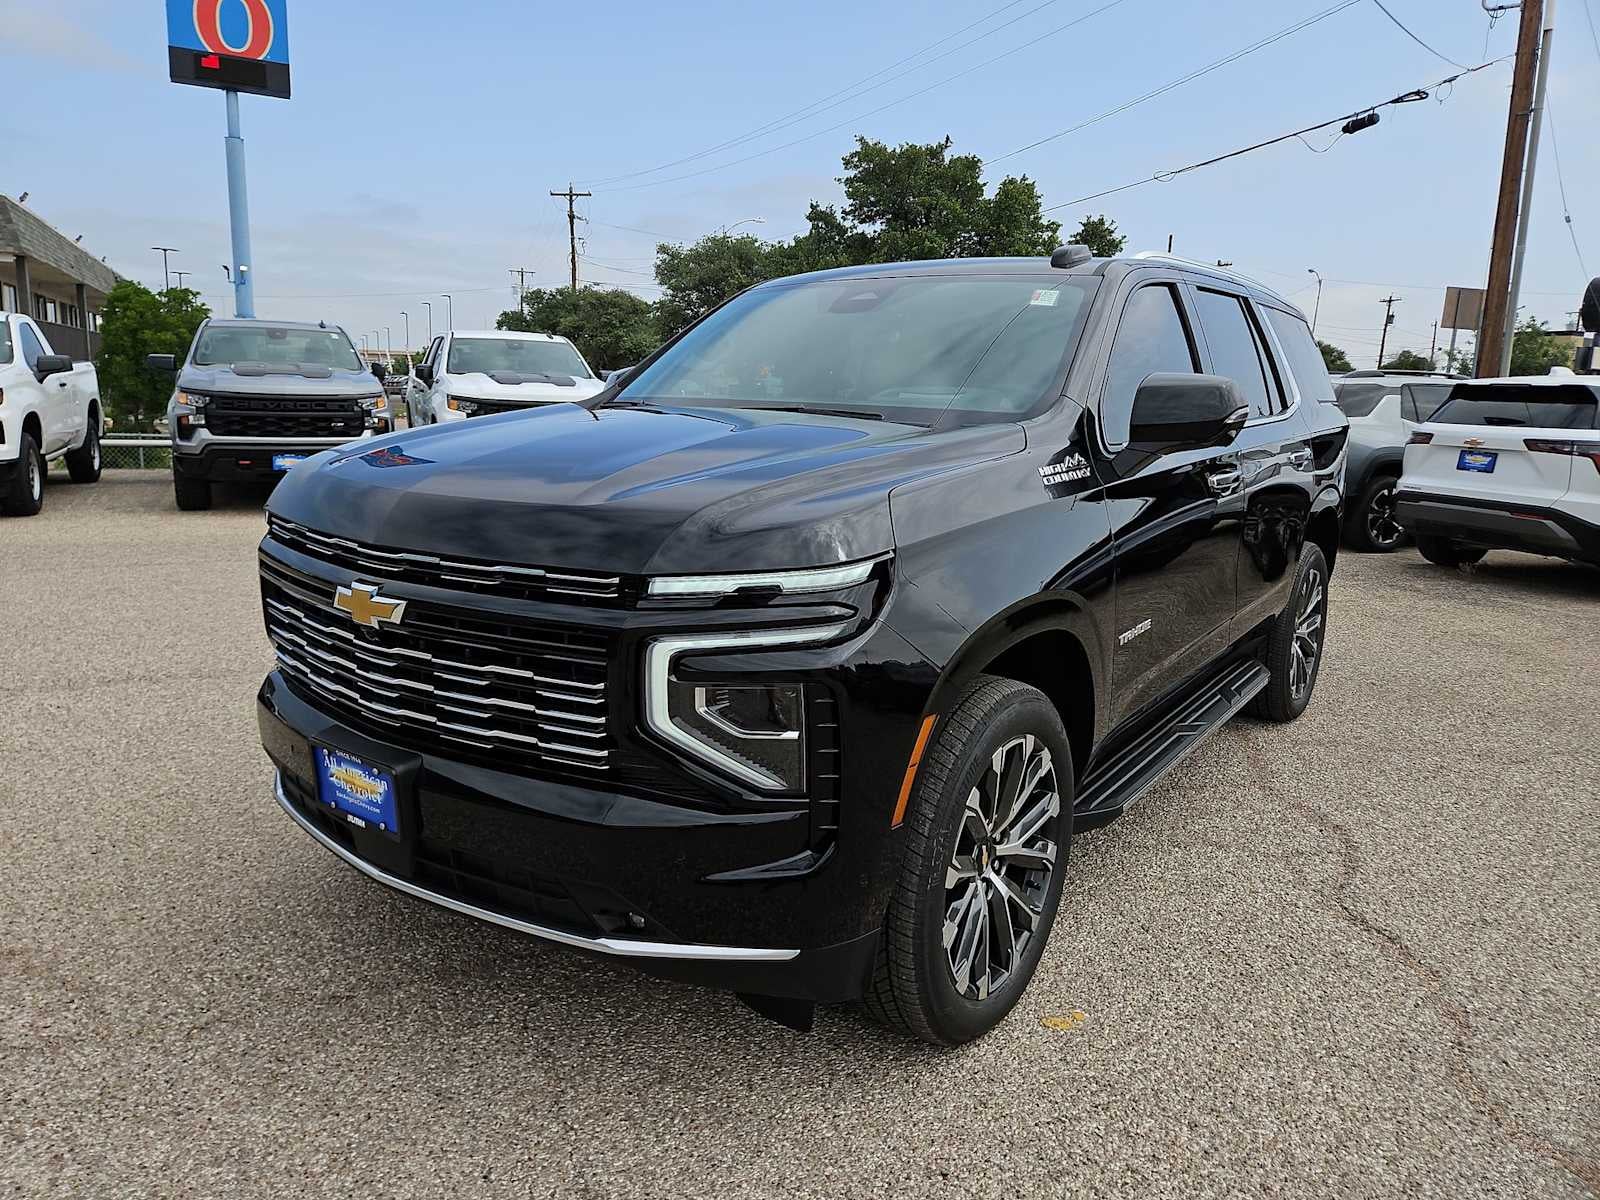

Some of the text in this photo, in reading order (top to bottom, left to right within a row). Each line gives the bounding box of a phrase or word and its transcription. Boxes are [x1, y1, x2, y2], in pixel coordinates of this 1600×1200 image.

[1038, 462, 1066, 476] HIGH
[1042, 467, 1091, 486] COUNTRY
[1118, 618, 1152, 646] TAHOE
[324, 755, 388, 791] All American
[333, 774, 383, 804] Chevrolet
